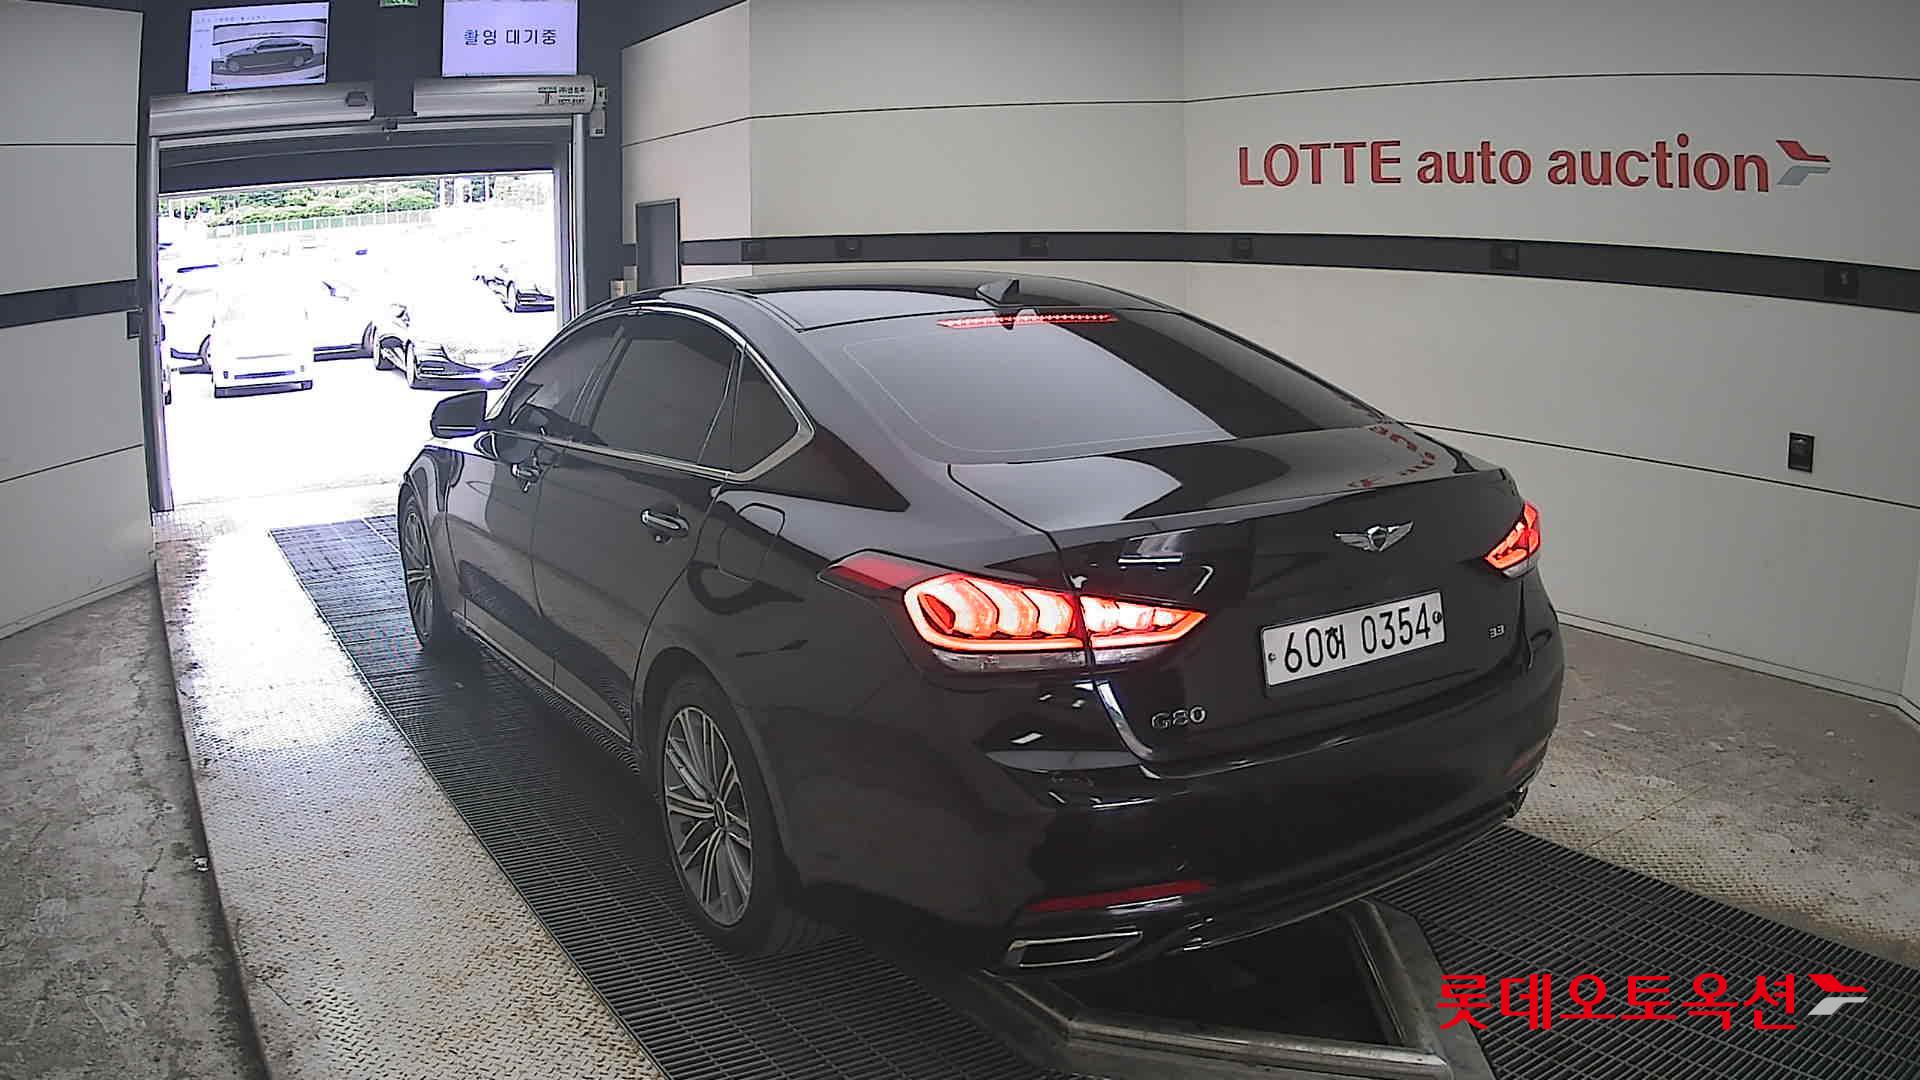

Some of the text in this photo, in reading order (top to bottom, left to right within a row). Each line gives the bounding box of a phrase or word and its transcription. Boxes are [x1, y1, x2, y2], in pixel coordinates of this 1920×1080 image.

[506, 29, 556, 45] 대기중
[1239, 133, 1770, 193] LOTTE auto auction
[1284, 602, 1430, 673] 60허 0354
[1151, 706, 1206, 729] G80
